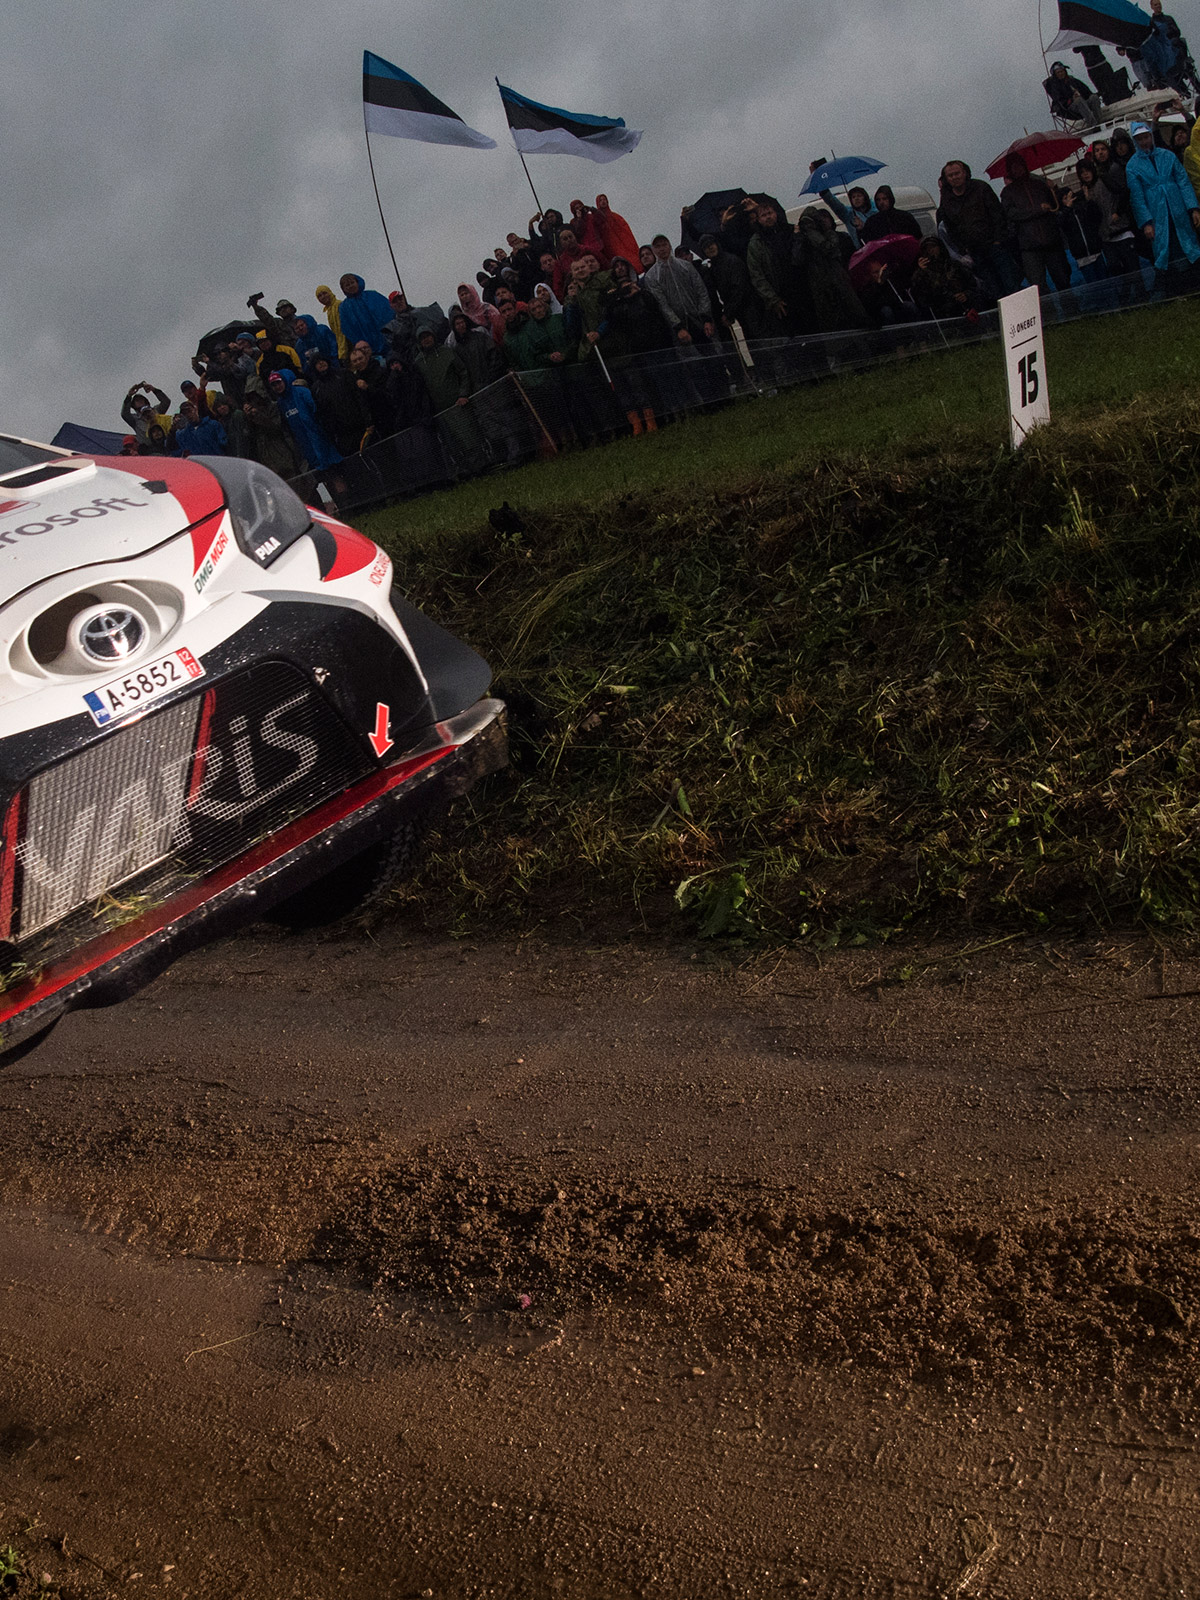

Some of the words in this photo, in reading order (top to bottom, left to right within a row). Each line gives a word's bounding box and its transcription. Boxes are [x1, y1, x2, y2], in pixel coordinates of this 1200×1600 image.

[1016, 316, 1037, 334] ONEBET
[1017, 350, 1039, 409] 15
[255, 536, 281, 561] PIAA
[194, 559, 214, 595] DMG
[210, 529, 229, 567] MORI
[179, 650, 192, 662] 12
